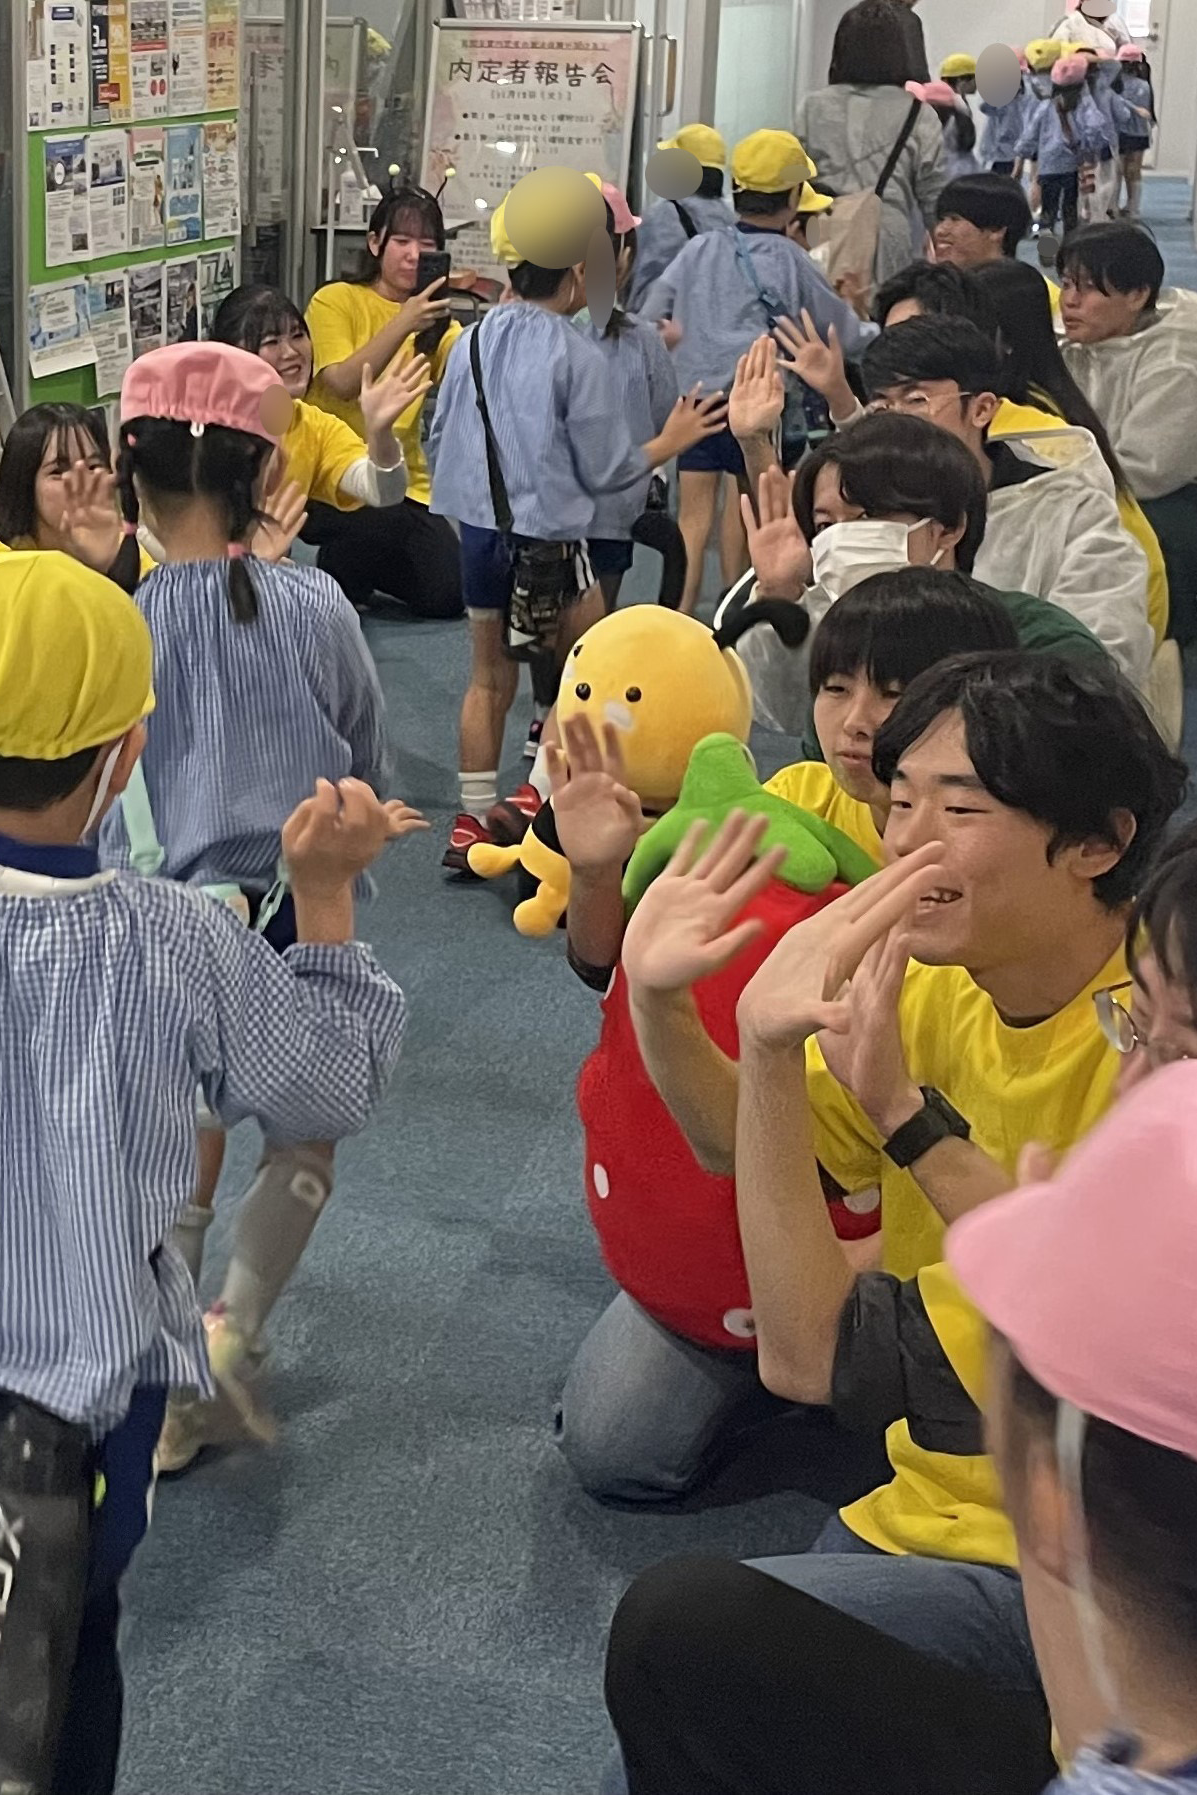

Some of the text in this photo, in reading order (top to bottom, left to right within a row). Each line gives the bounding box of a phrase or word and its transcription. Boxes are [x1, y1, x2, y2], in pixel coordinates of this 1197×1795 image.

[448, 58, 616, 87] 内定者報告会
